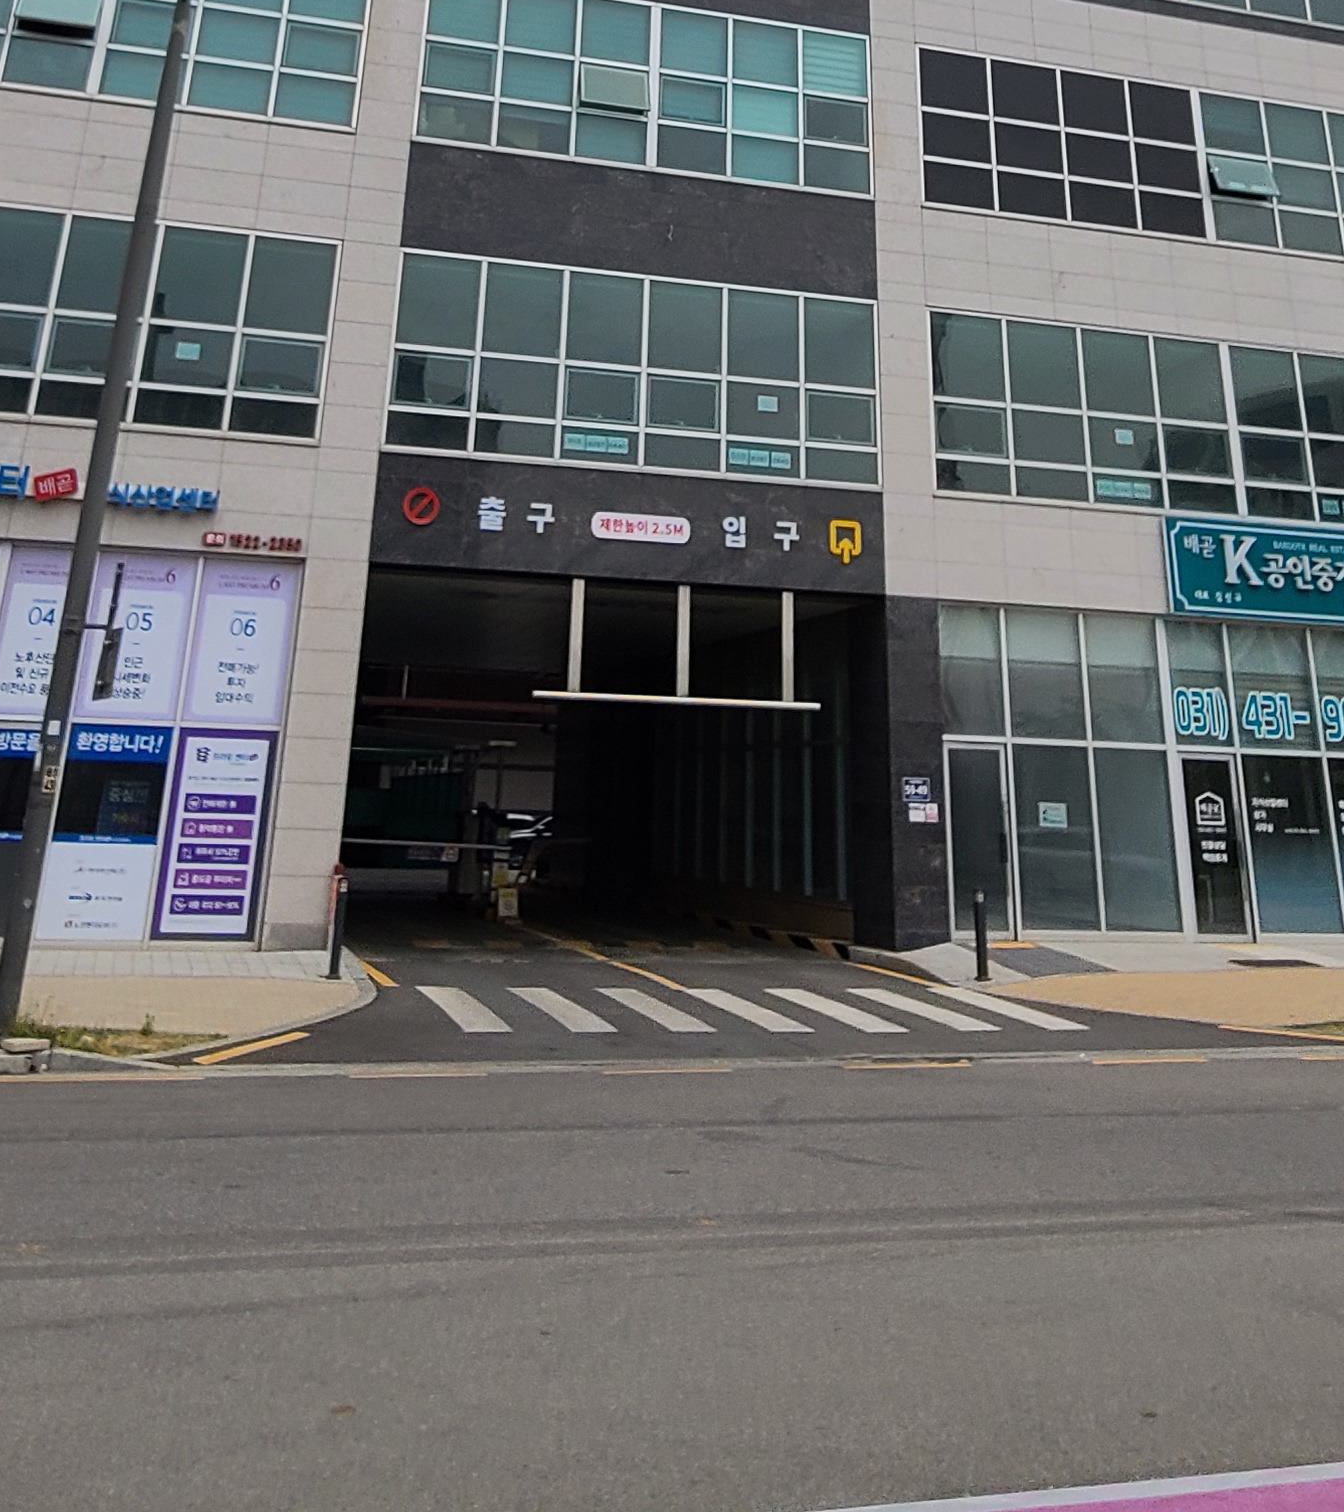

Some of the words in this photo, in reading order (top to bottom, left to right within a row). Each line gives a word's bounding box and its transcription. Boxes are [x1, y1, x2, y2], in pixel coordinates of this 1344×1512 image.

[108, 482, 220, 513] 식산업센터
[478, 496, 555, 534] 출구
[600, 517, 648, 535] 제한높이
[652, 521, 684, 537] 2.5M
[722, 516, 800, 552] 입구
[1219, 534, 1264, 587] K
[165, 568, 177, 585] 6
[269, 573, 282, 591] 6
[28, 606, 56, 627] 04
[126, 611, 153, 632] 05
[230, 618, 257, 638] 06
[1174, 686, 1229, 740] 031)
[1242, 691, 1310, 740] 431-
[75, 731, 164, 755] 환영합니다!
